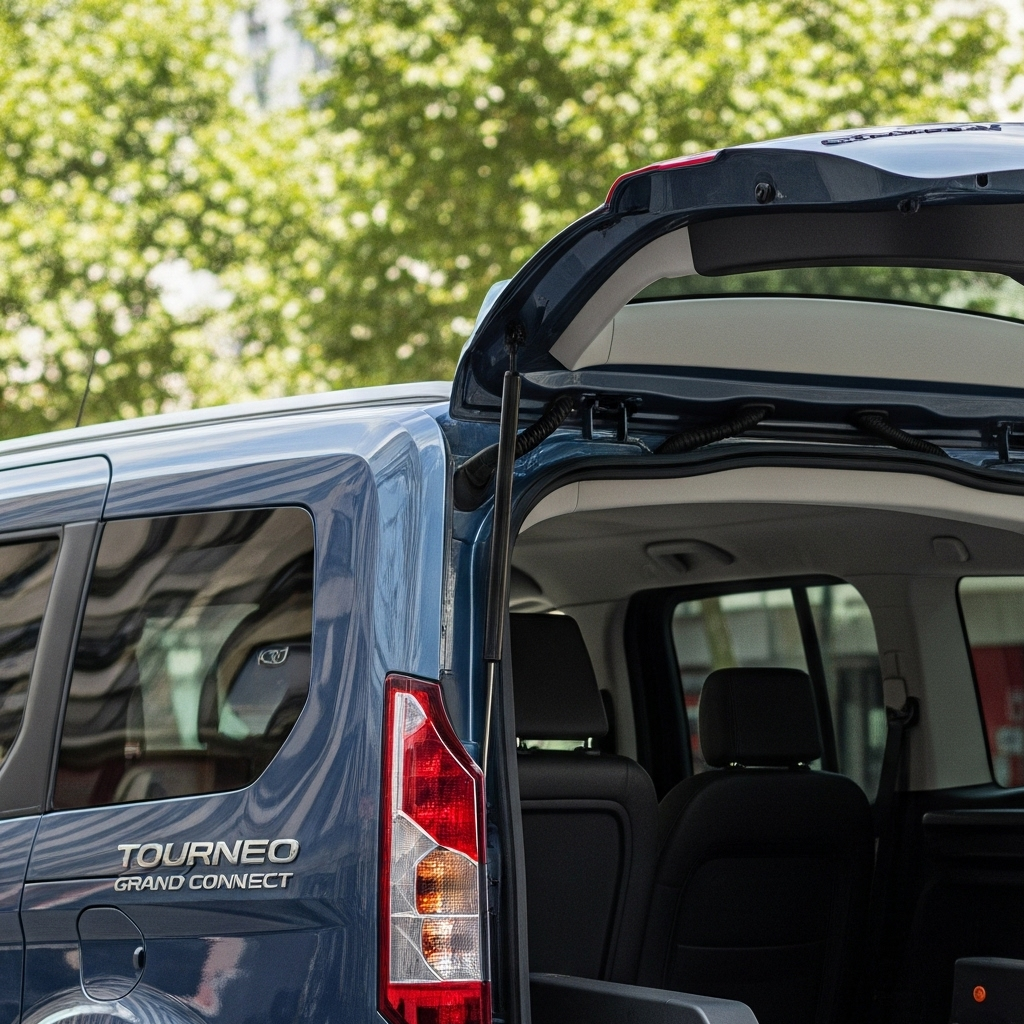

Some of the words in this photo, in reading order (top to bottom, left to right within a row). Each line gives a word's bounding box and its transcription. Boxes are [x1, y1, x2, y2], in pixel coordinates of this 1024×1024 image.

[117, 838, 300, 868] TOURNEO
[114, 874, 186, 892] GRAND
[188, 872, 294, 890] CONNECT
